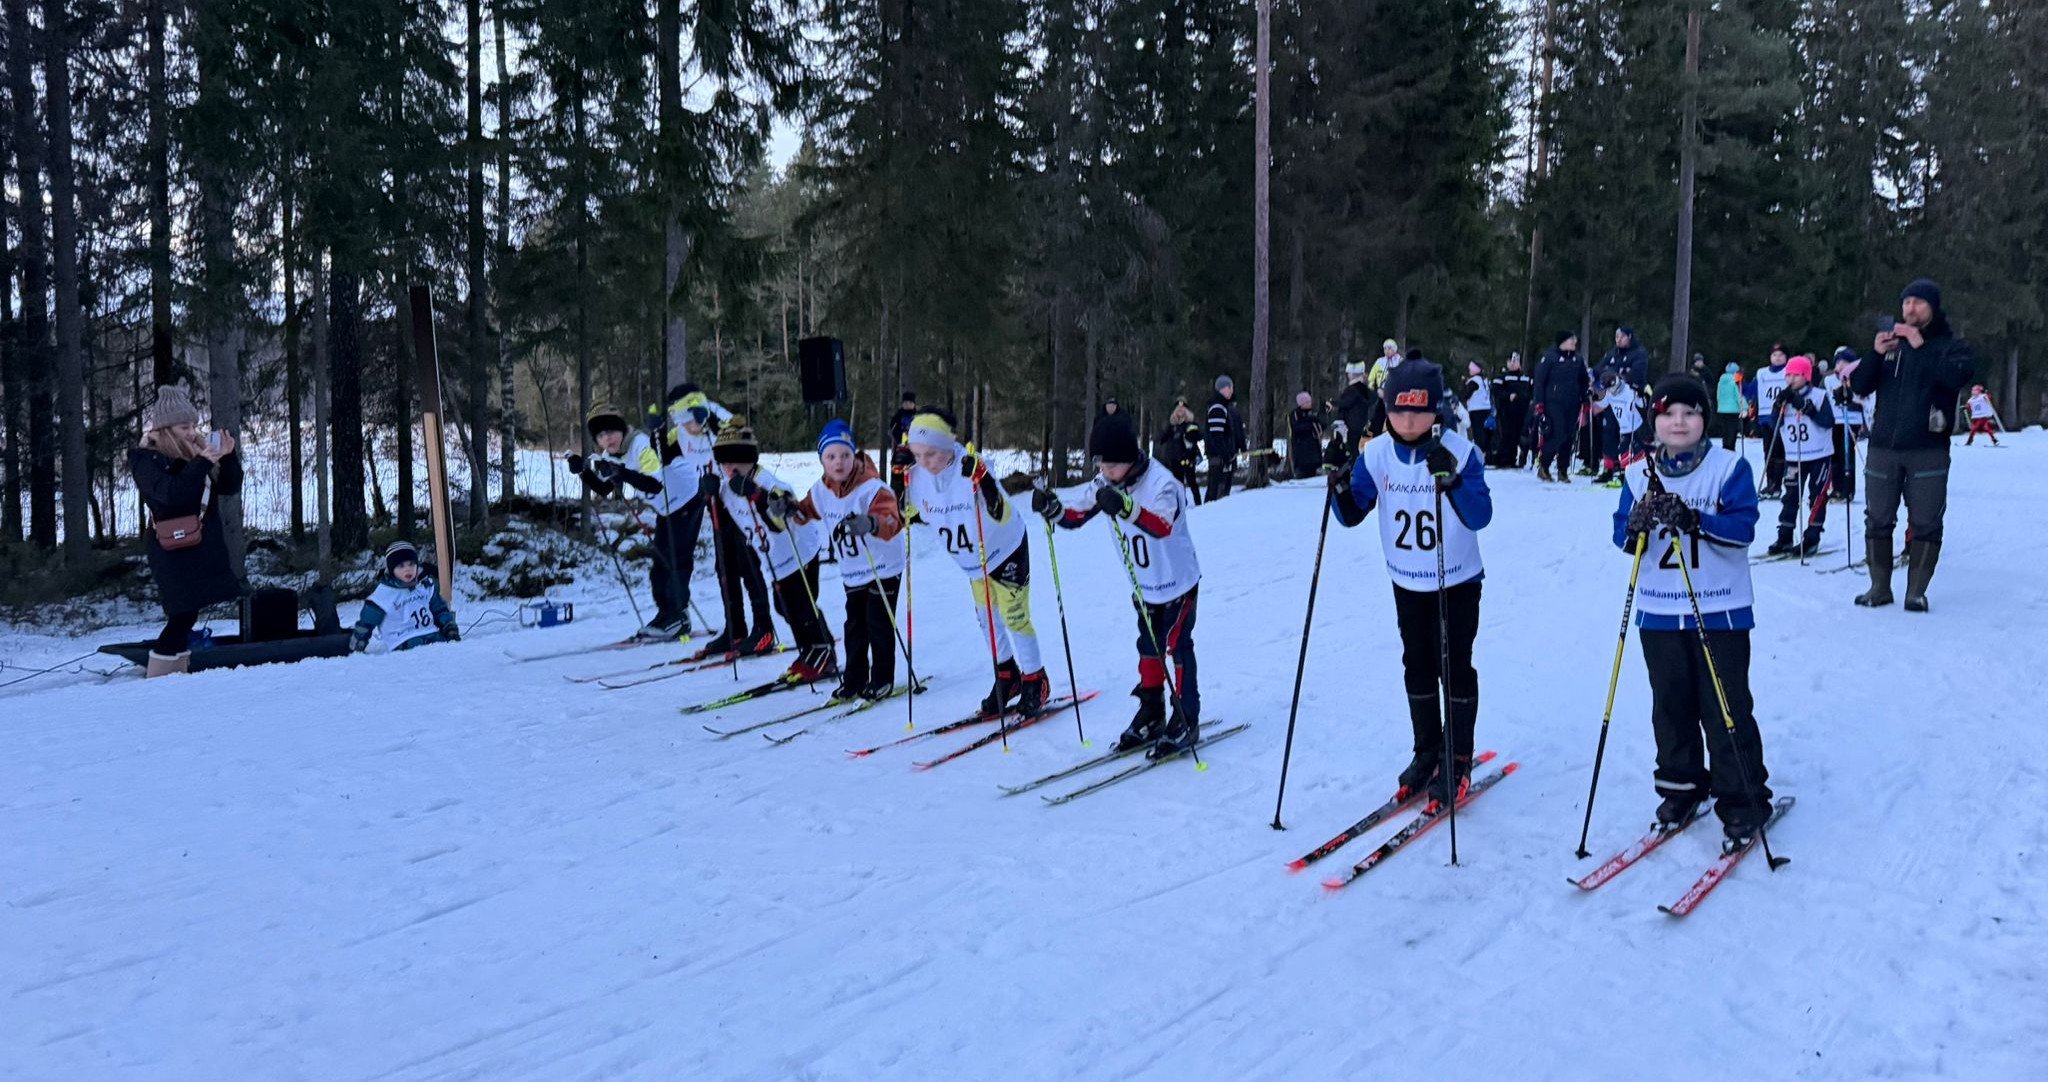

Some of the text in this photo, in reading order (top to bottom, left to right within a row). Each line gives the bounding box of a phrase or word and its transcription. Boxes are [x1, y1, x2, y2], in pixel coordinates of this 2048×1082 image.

[1766, 386, 1782, 401] 40
[1787, 423, 1809, 443] 38
[938, 523, 974, 555] 24
[1395, 509, 1437, 551] 26
[1658, 526, 1700, 569] 21
[1639, 587, 1702, 600] Kankaanpän
